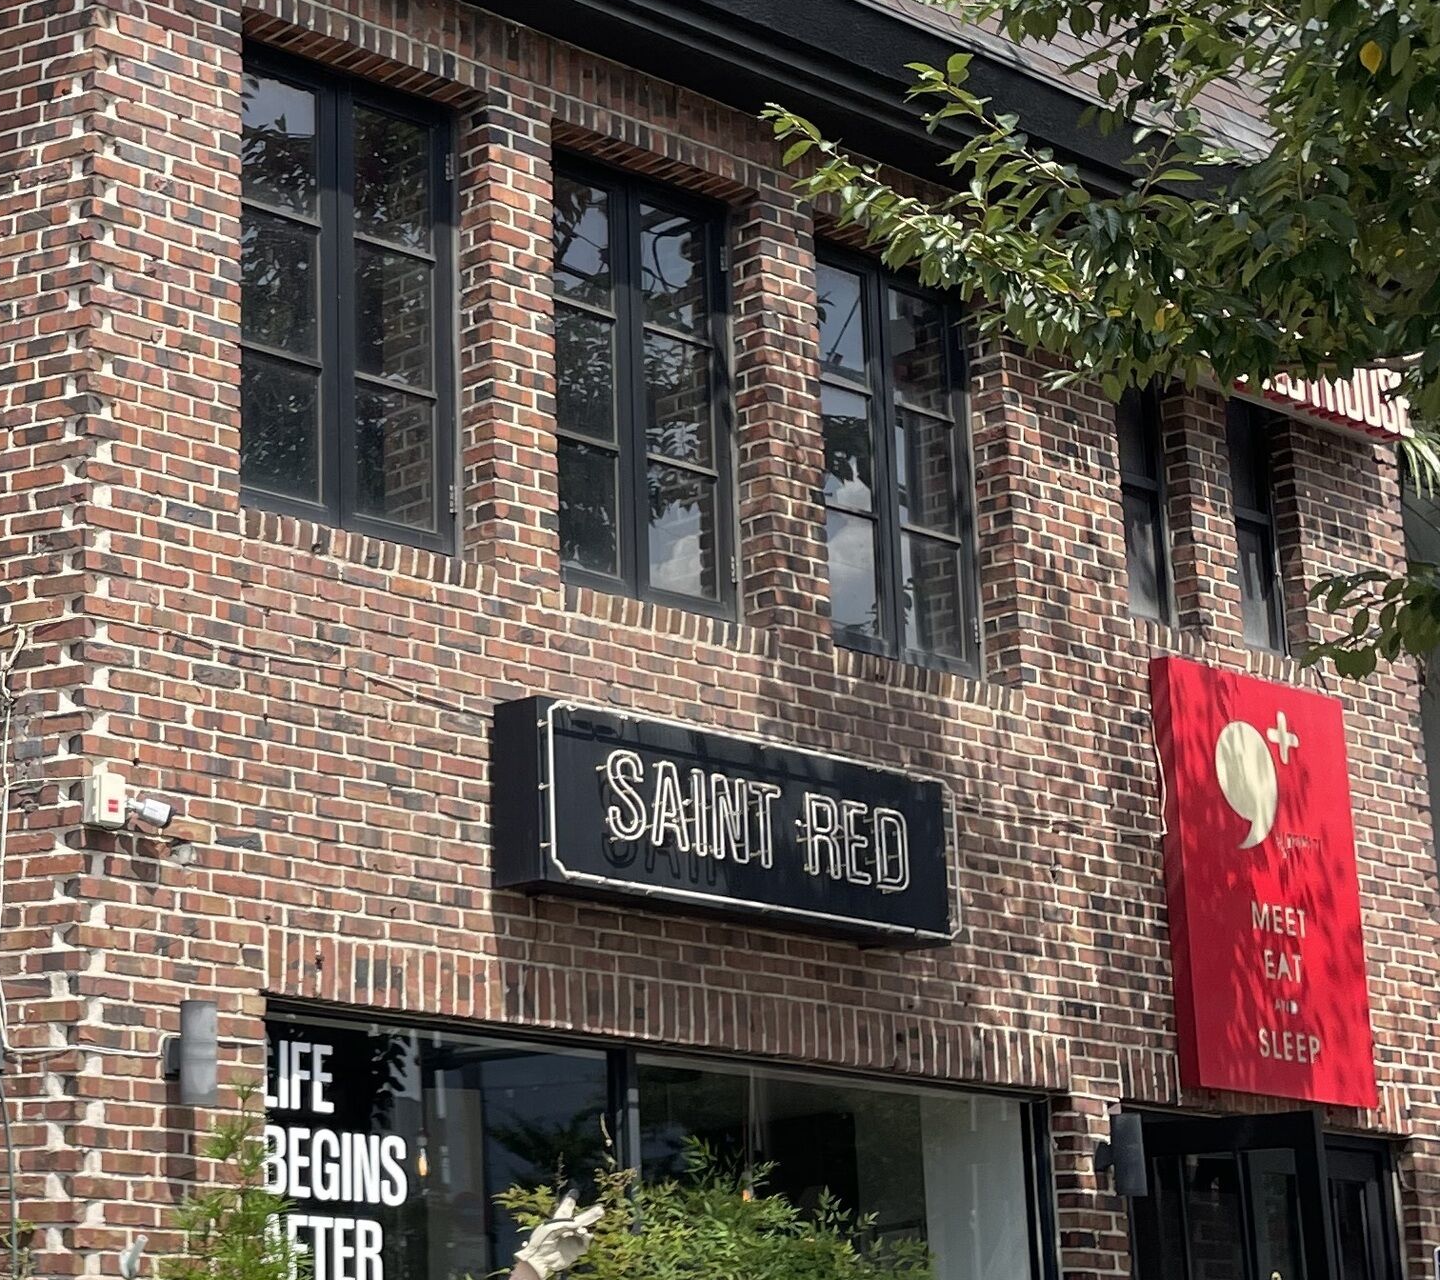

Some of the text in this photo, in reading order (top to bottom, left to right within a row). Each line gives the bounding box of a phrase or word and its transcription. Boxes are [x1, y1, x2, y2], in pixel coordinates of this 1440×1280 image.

[606, 749, 911, 892] SAINT RED
[1251, 900, 1306, 939] MEET
[1264, 948, 1302, 984] EAT
[1258, 1027, 1321, 1065] SLEEP
[263, 1124, 408, 1207] BEGINS
